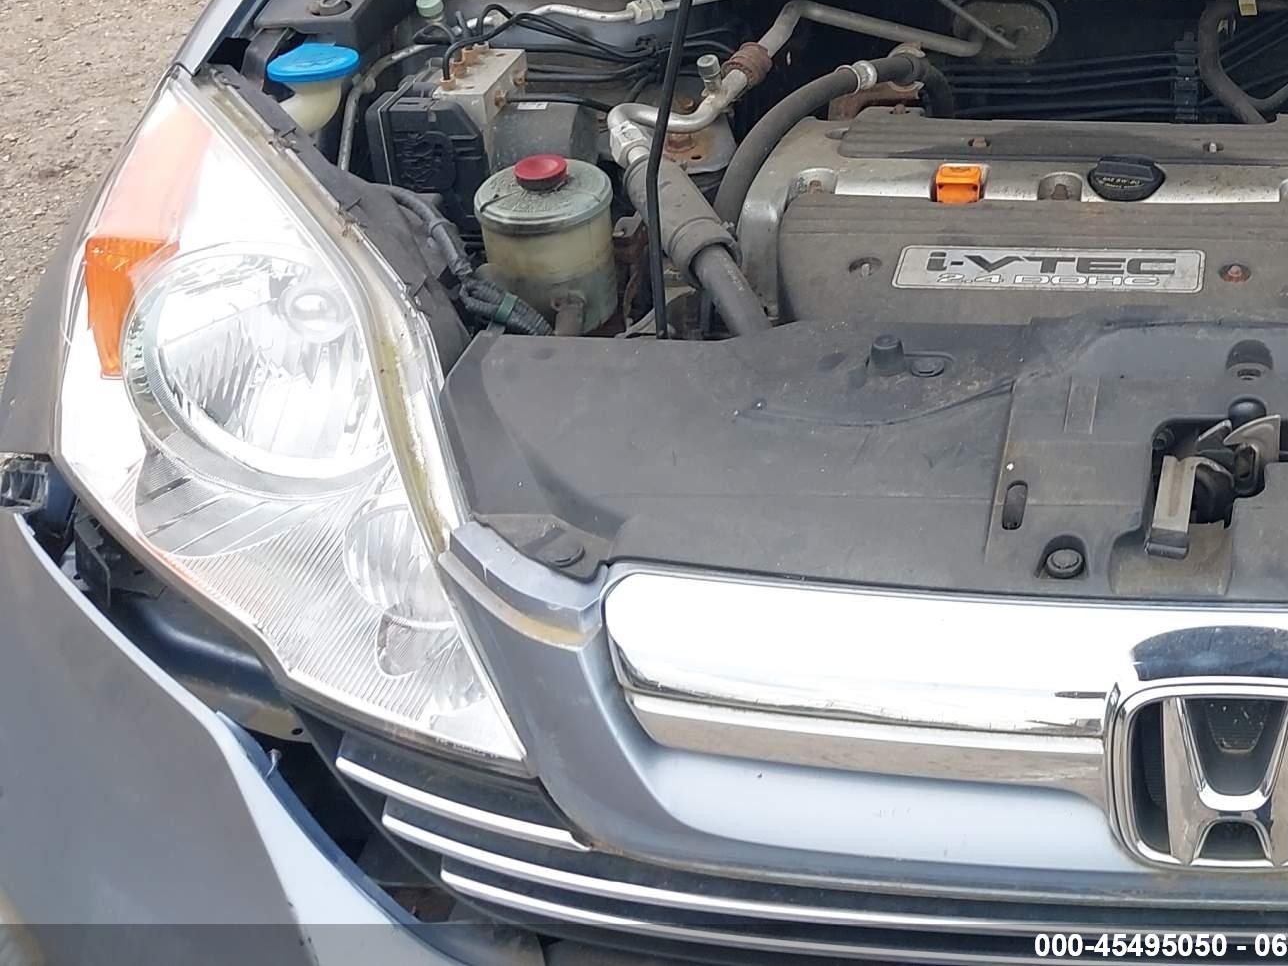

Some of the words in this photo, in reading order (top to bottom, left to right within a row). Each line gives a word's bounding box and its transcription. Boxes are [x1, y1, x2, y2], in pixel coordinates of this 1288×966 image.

[926, 251, 1177, 276] i-VTEC
[936, 273, 1002, 284] 2.4
[1013, 274, 1160, 287] DOHC
